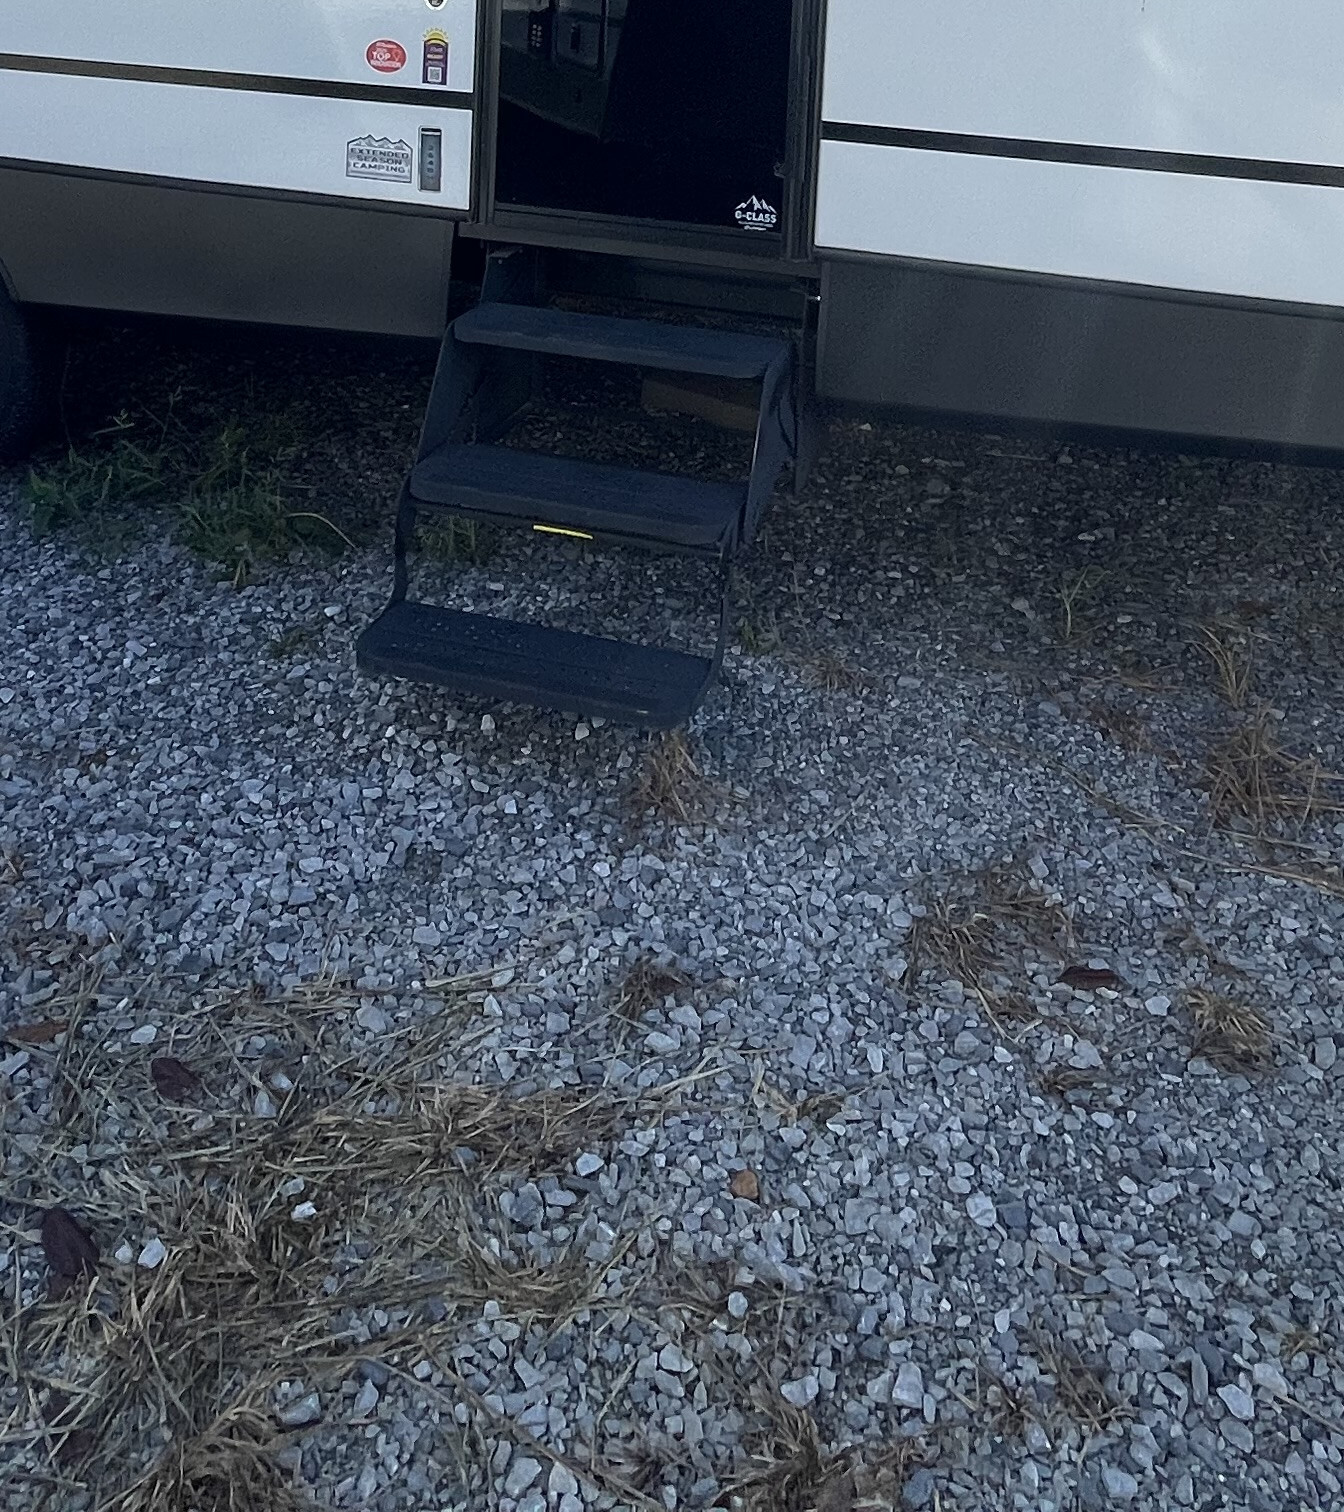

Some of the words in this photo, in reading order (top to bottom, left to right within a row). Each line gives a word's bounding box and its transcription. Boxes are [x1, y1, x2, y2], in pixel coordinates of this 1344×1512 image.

[350, 147, 409, 159] EXTENDED
[357, 154, 403, 166] SEASON
[353, 162, 406, 174] CAMPING
